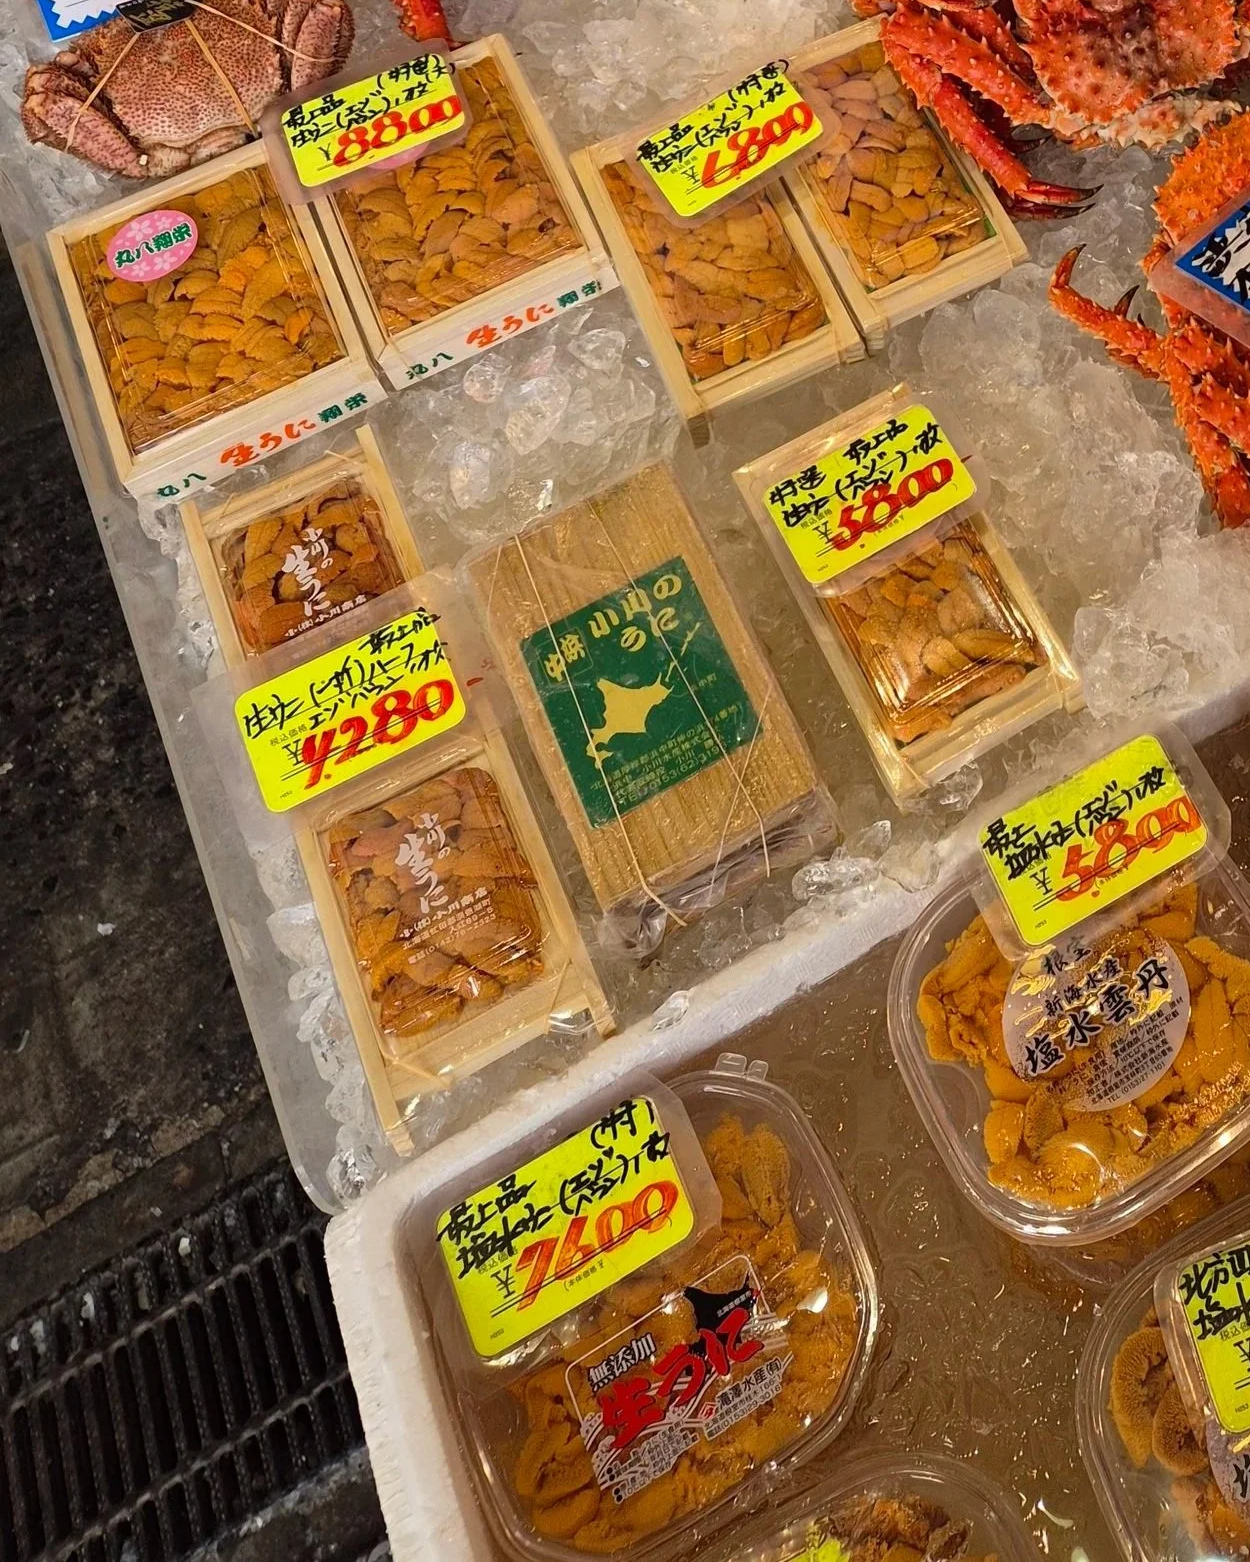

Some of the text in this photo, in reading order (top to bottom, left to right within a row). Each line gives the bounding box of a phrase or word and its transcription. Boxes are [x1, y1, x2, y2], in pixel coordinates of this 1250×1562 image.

[318, 93, 466, 170] ¥8800
[686, 99, 814, 190] ¥6800
[219, 417, 318, 469] 生うに
[811, 458, 956, 552] ¥5800
[587, 572, 684, 640] 小川の
[619, 606, 681, 654] うに
[281, 678, 458, 792] ¥4280
[1033, 795, 1204, 903] ¥5800
[1021, 956, 1172, 1077] 塩水雲丹
[490, 1179, 681, 1311] ¥7600
[586, 1330, 656, 1395] 無添加
[598, 1307, 767, 1450] 生うに
